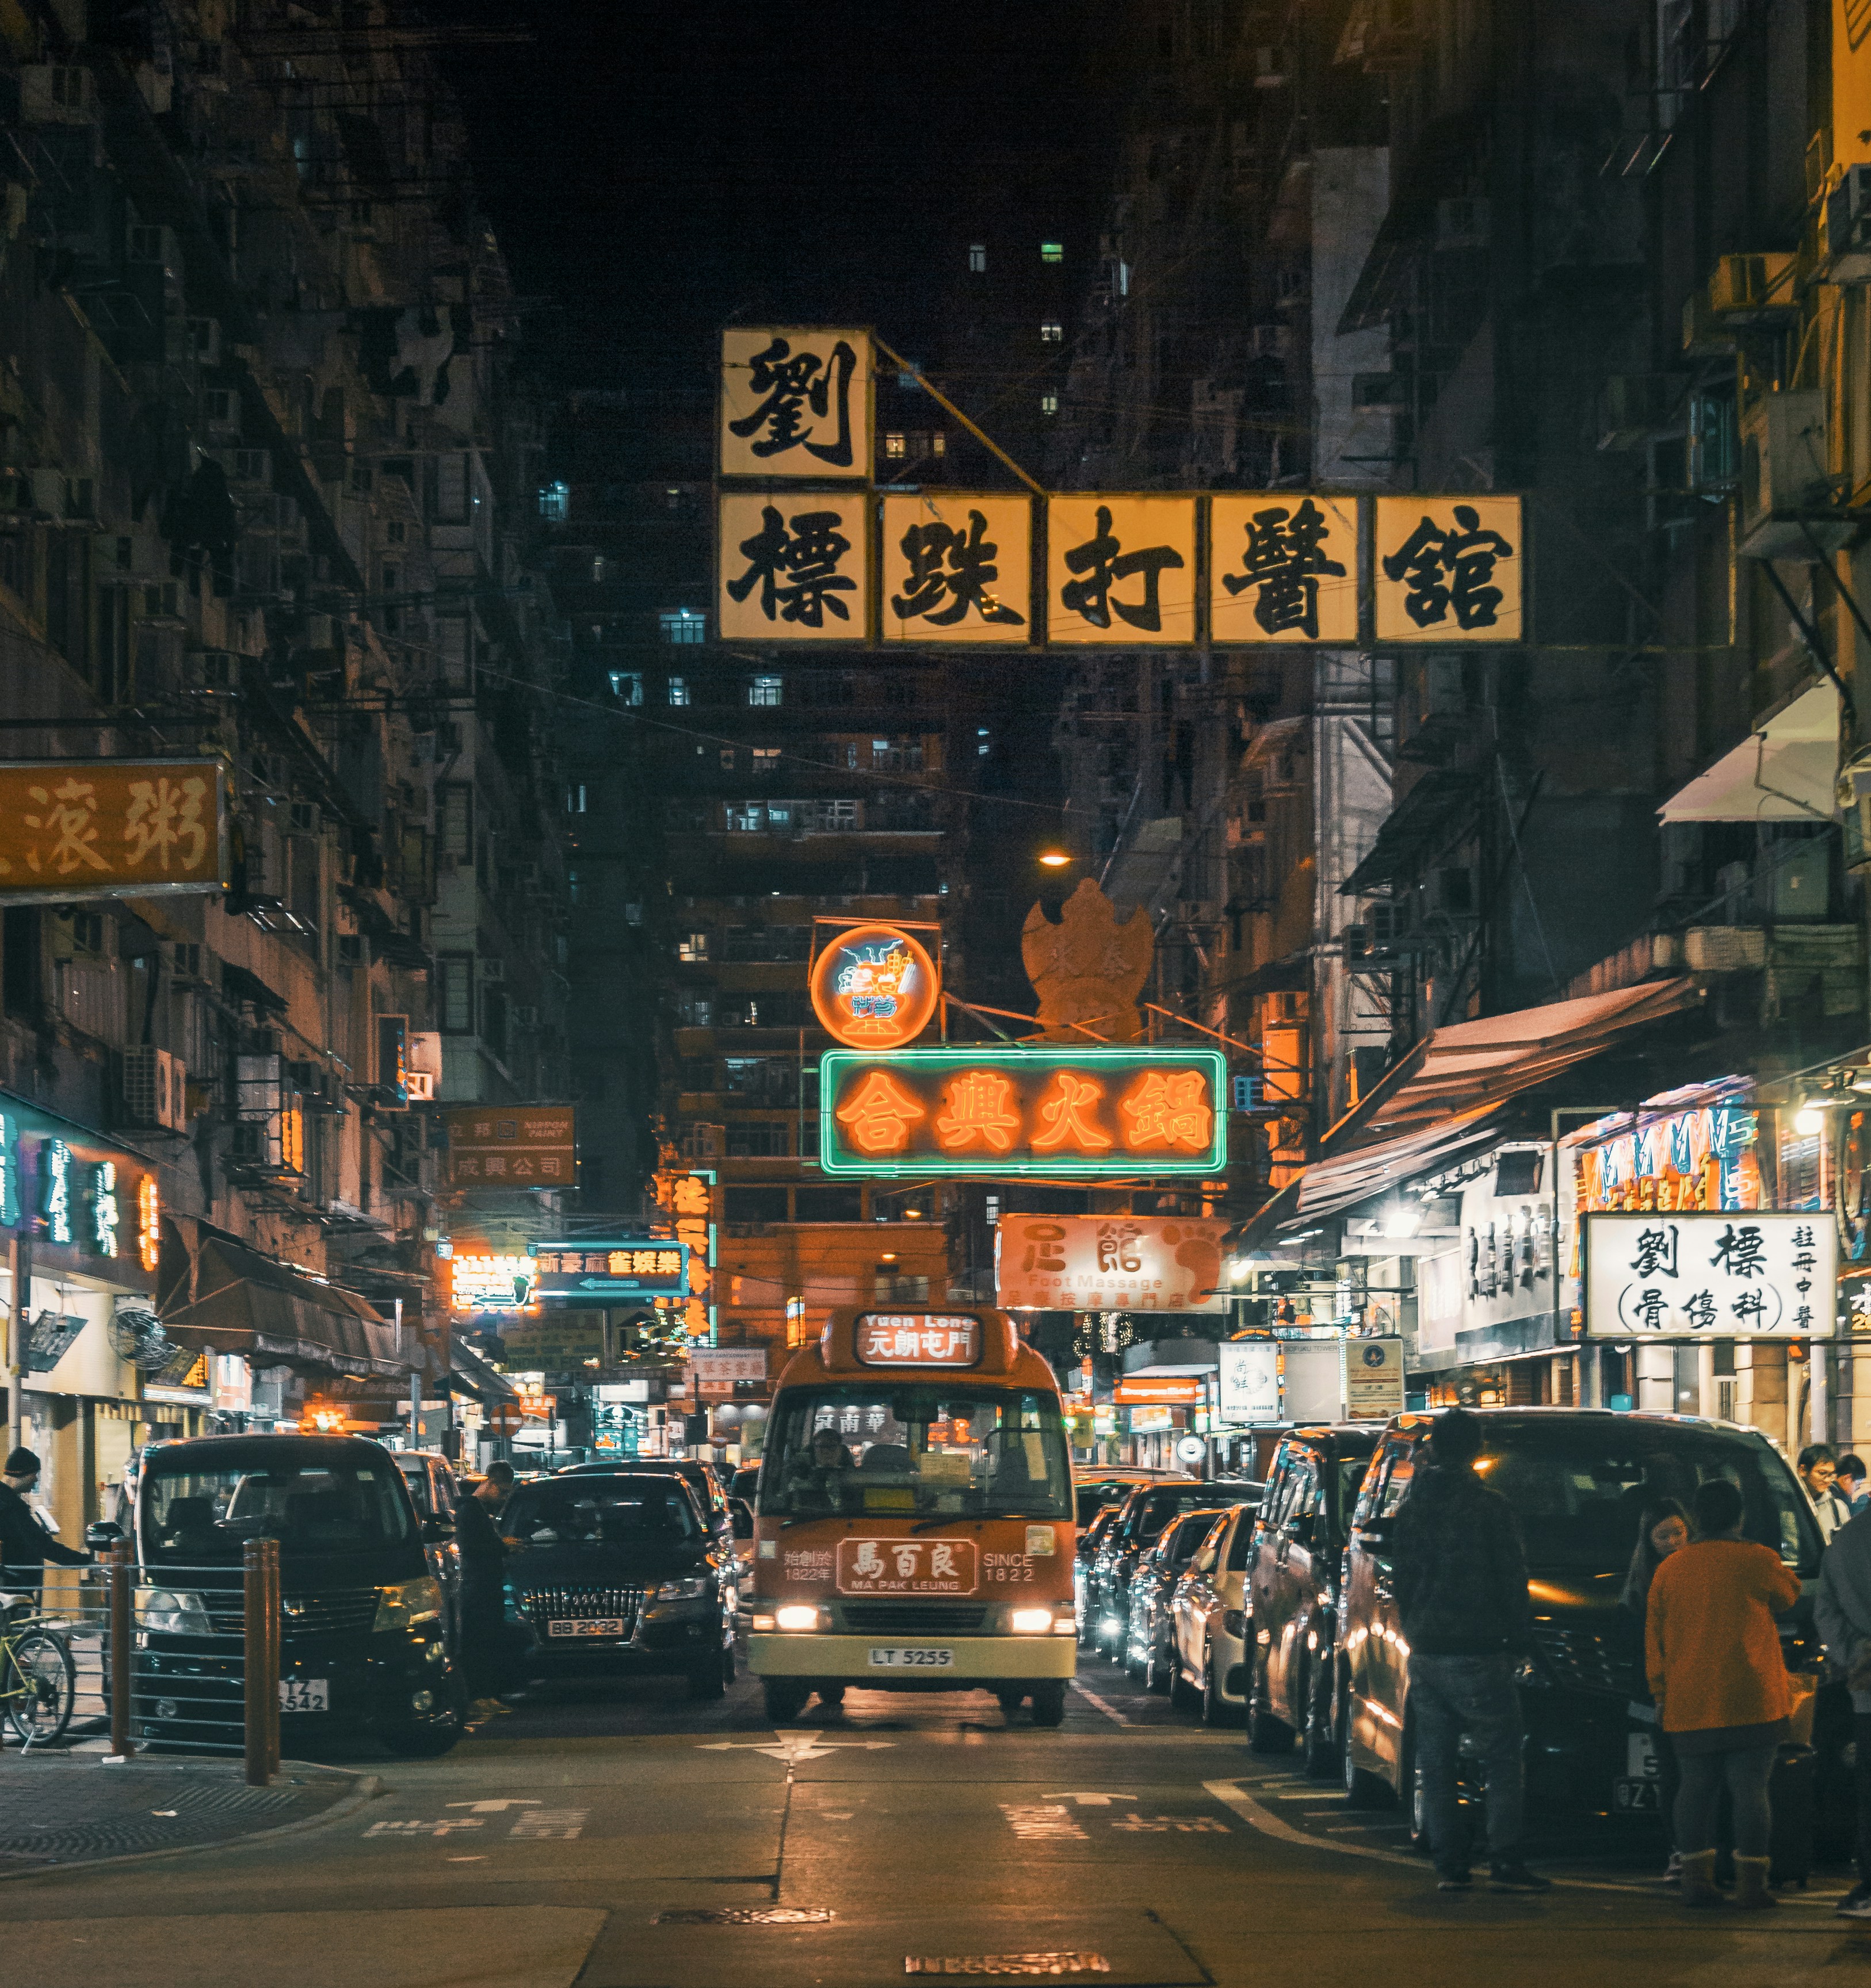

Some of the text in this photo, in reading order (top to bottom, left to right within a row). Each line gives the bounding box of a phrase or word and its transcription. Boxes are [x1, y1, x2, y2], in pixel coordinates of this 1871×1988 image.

[728, 337, 857, 467] 劉
[727, 498, 1513, 639] 標跌打醫館
[837, 1071, 1211, 1151] 合興火鍋
[1631, 1224, 1767, 1279] 劉標
[1028, 1275, 1163, 1290] Foot Massage
[1790, 1226, 1817, 1330] 註冊中醫
[866, 1315, 916, 1328] Yuen
[866, 1330, 971, 1358] 元朗屯門
[852, 1542, 961, 1579] 馬百良
[983, 1553, 1034, 1566] SINCE
[785, 1568, 831, 1581] 1822年
[985, 1569, 1034, 1581] 1822
[852, 1581, 960, 1590] MA PAK LEUNG
[872, 1650, 950, 1665] LT 5255
